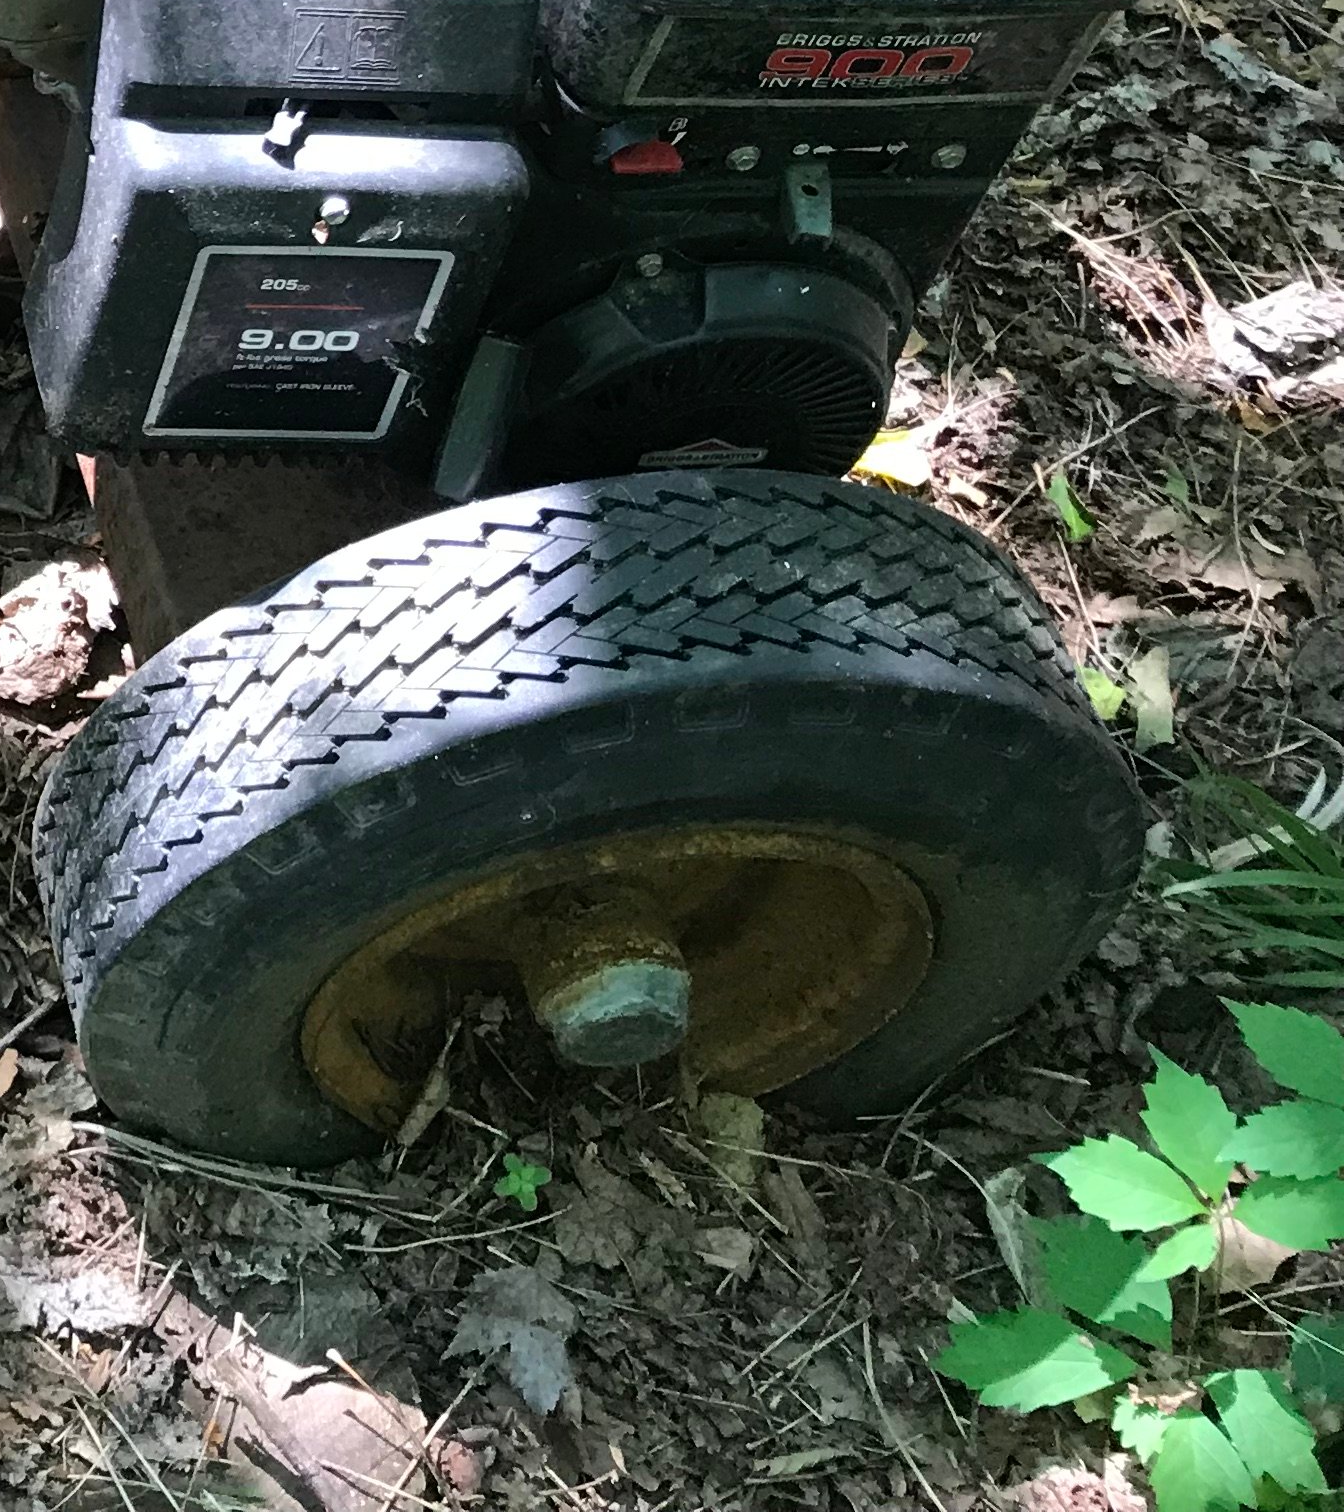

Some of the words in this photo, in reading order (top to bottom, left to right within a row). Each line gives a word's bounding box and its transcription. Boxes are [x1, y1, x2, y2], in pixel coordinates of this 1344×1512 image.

[760, 46, 974, 80] 900
[759, 76, 850, 89] INTEK
[237, 328, 360, 352] 9.00
